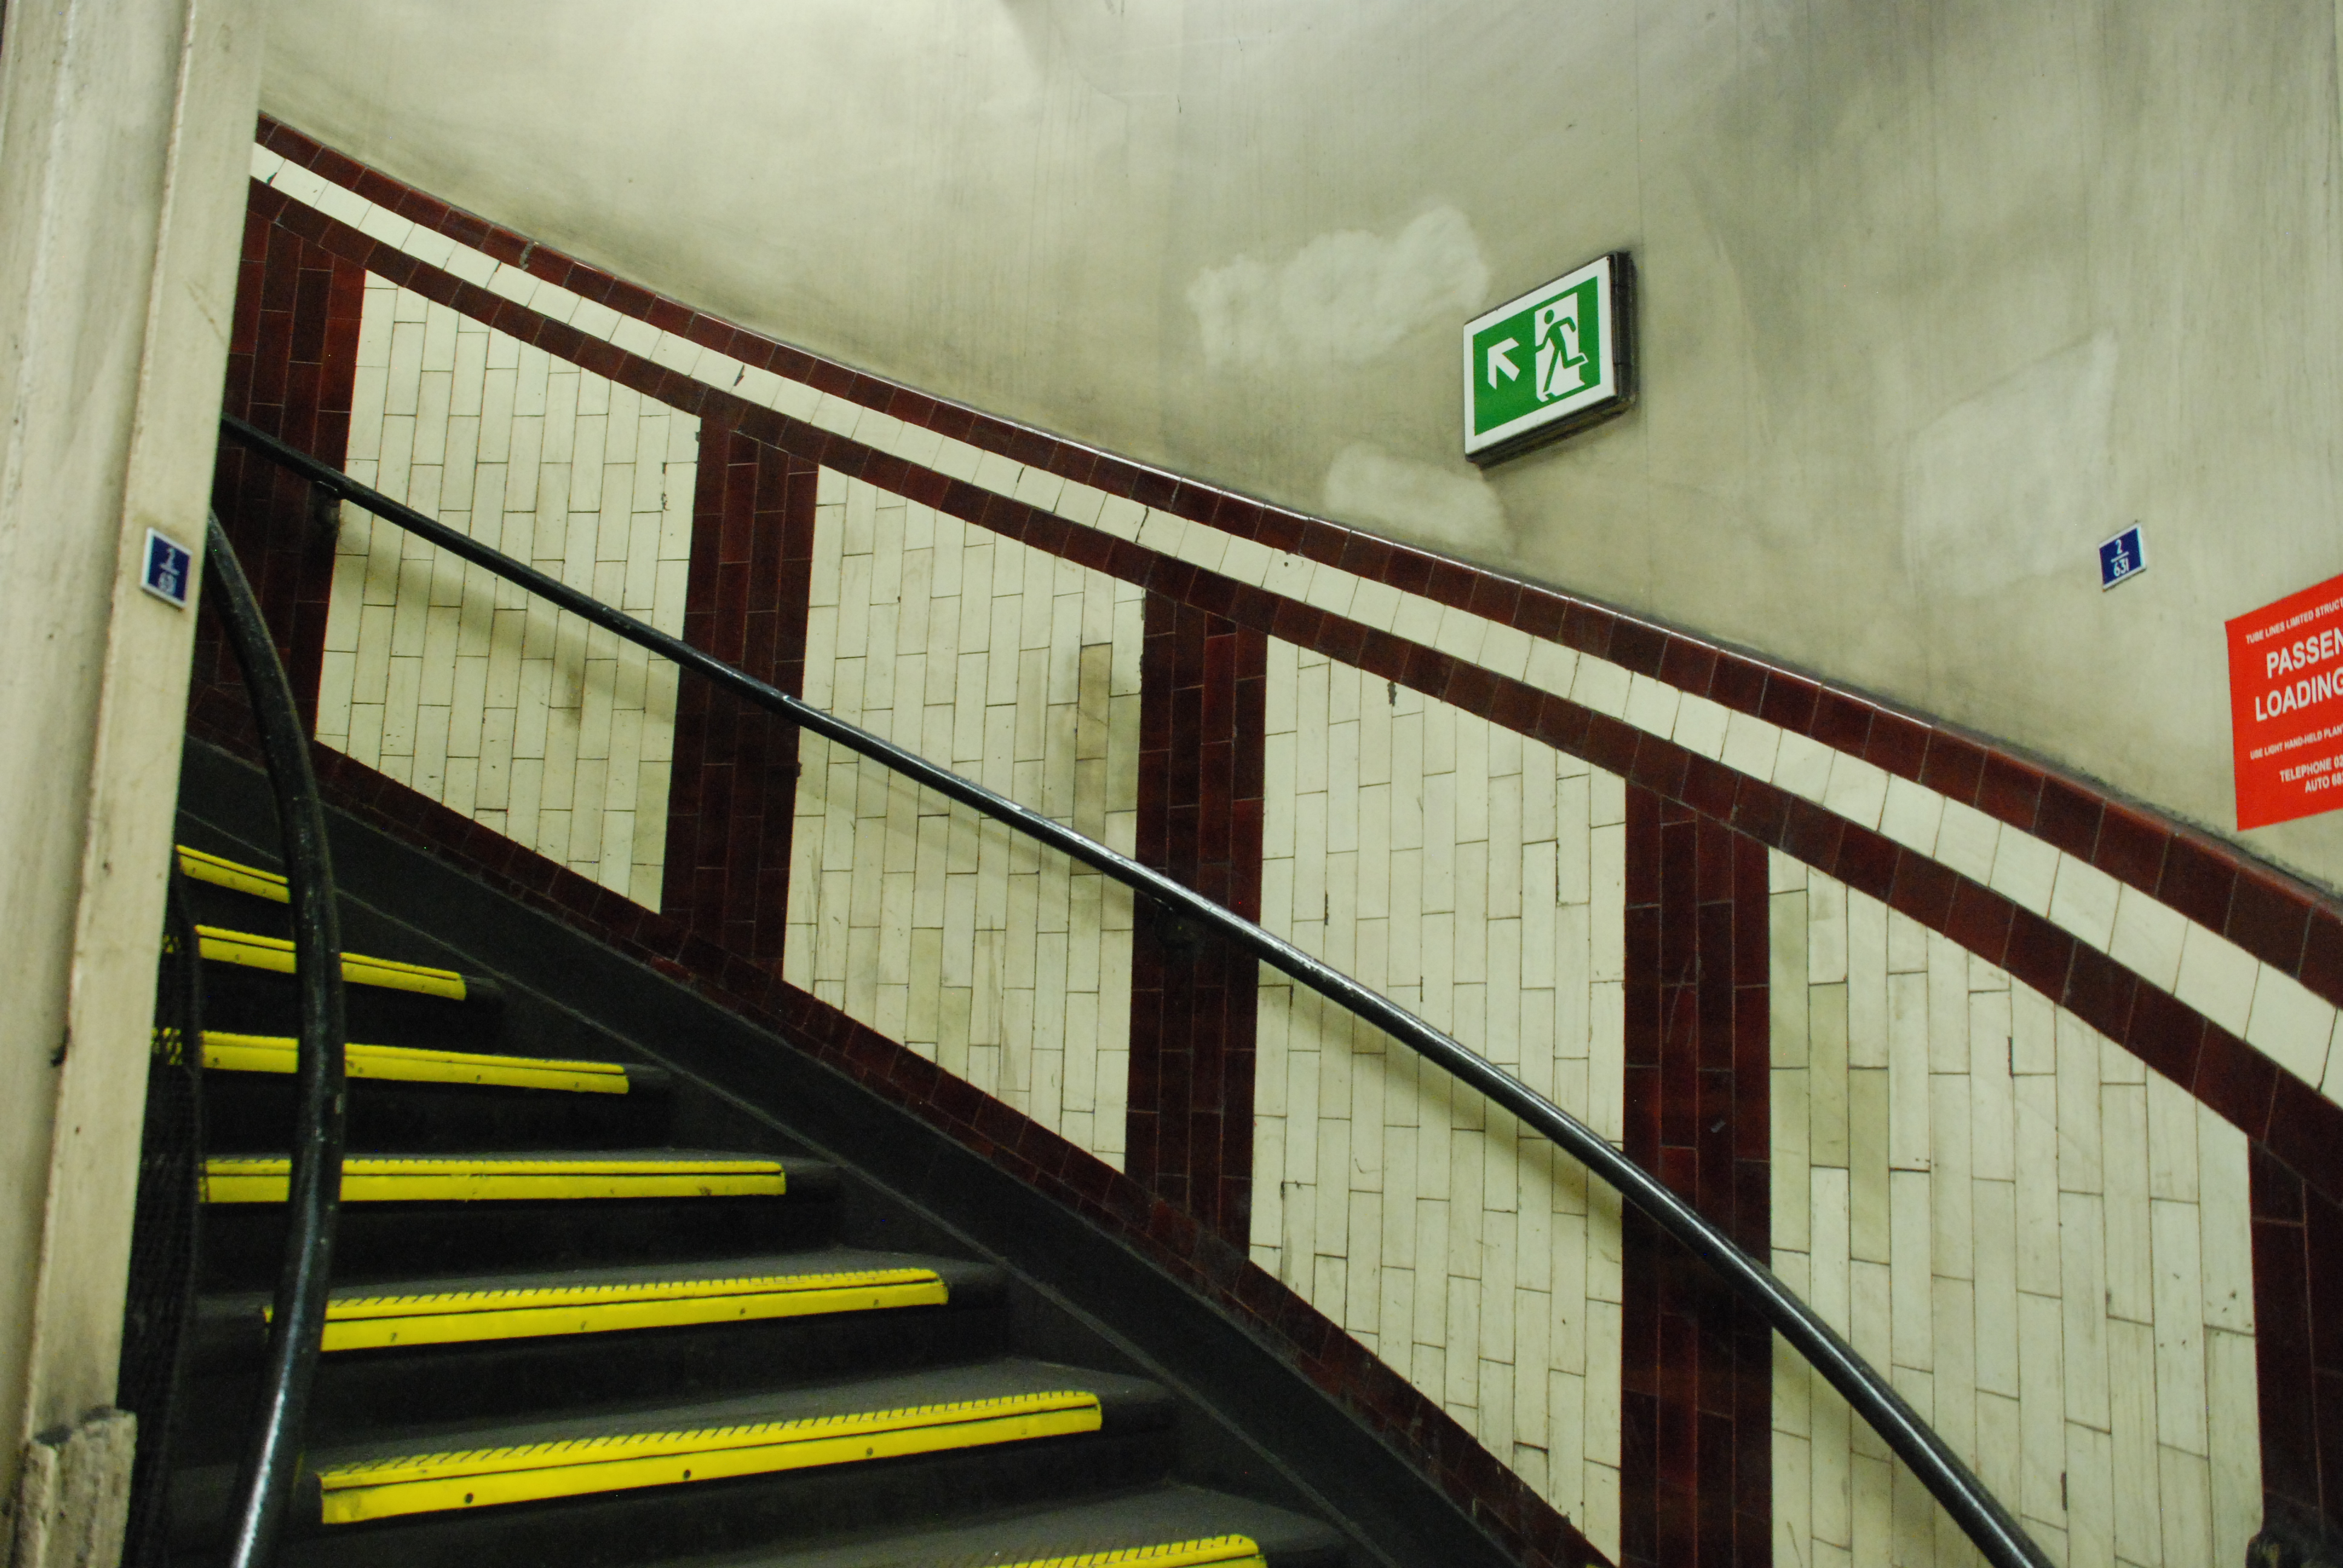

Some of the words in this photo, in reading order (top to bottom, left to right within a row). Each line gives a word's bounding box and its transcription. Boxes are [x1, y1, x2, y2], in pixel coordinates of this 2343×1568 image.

[2115, 539, 2122, 554] 2
[2265, 621, 2285, 638] LINES
[2286, 610, 2314, 630] LIMITED
[2264, 742, 2282, 756] LIGHT
[2324, 723, 2343, 739] PLAN
[2279, 757, 2332, 782] TELEPHONE
[2305, 776, 2330, 793] AUTO
